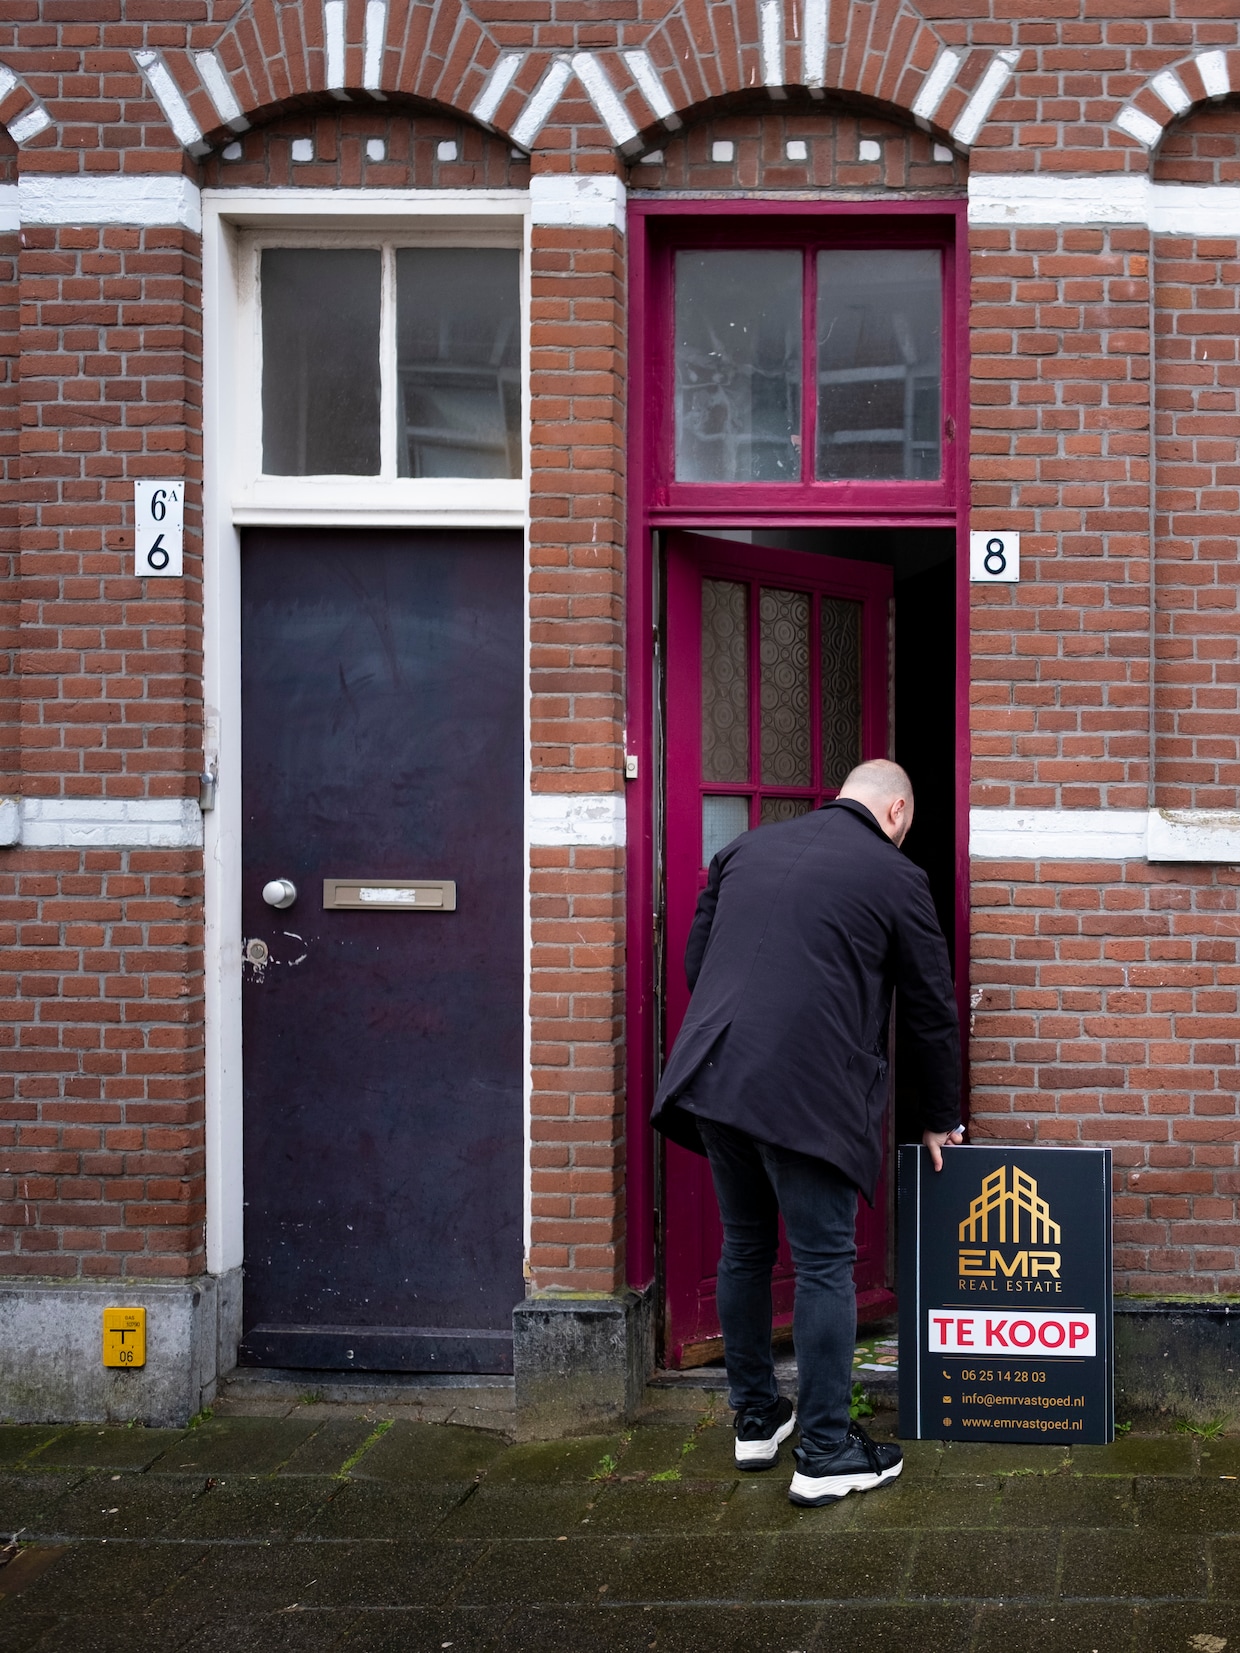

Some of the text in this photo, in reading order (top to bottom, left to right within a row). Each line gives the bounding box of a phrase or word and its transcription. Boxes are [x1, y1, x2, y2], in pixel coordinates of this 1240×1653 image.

[147, 533, 170, 570] 6
[984, 538, 1006, 574] 8
[958, 1249, 1061, 1278] EMR
[958, 1279, 1063, 1293] REAL ESTATE
[933, 1318, 1090, 1349] TE KOOP
[120, 1350, 134, 1363] 06
[961, 1369, 1047, 1383] 06 25 14 28 03
[961, 1392, 1085, 1409] info@emrvastgoed.nl
[961, 1417, 1083, 1432] www.emrvastgoed.nl
